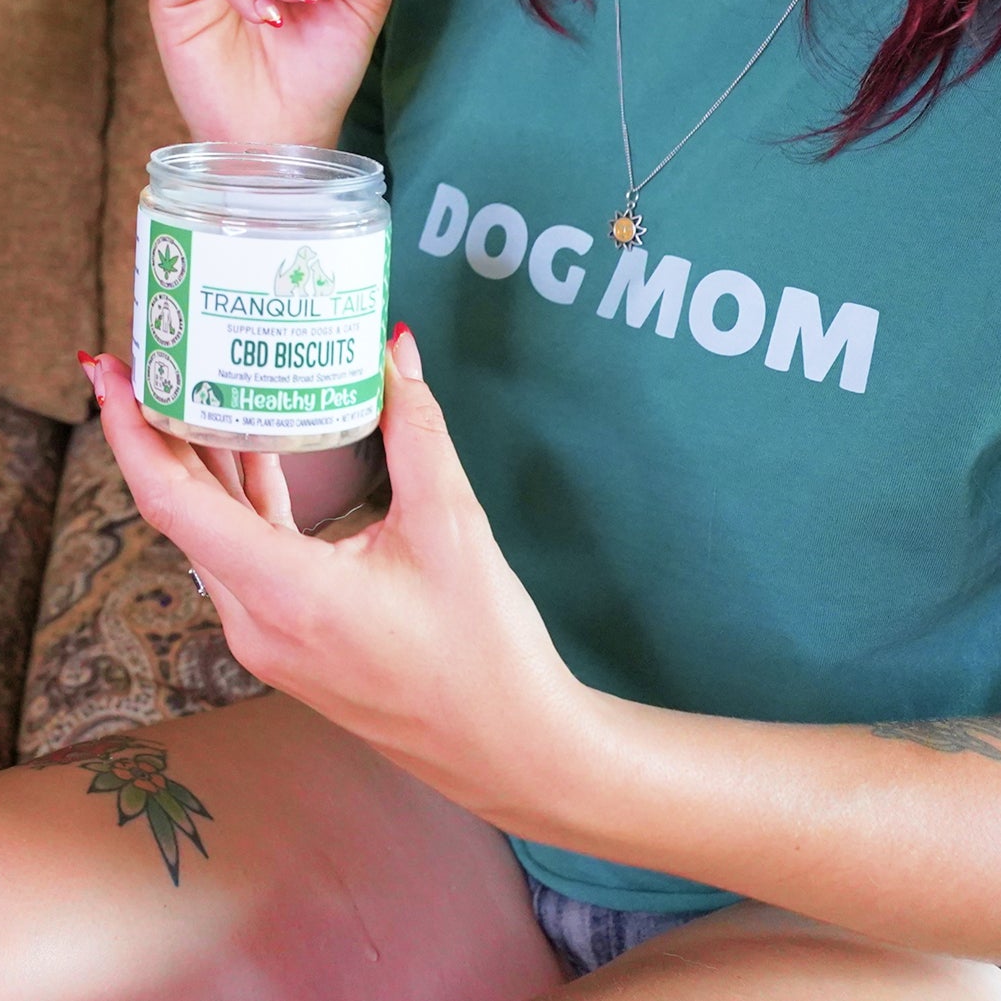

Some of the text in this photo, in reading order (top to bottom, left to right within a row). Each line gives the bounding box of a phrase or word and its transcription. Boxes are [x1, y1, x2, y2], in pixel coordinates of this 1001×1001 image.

[418, 182, 880, 394] DOG MOM
[200, 289, 377, 317] TRANQUIL TAILS
[227, 324, 287, 337] SUPPLEMENT
[291, 327, 308, 337] FOR
[311, 326, 333, 337] DOGS
[230, 337, 355, 369] CBD BISCUITS
[218, 369, 252, 383] Naturally
[254, 372, 290, 383] Extracted
[292, 374, 314, 383] Broad
[239, 387, 316, 412] Healthy
[321, 387, 358, 410] Pets
[207, 411, 233, 424] BISCUITS
